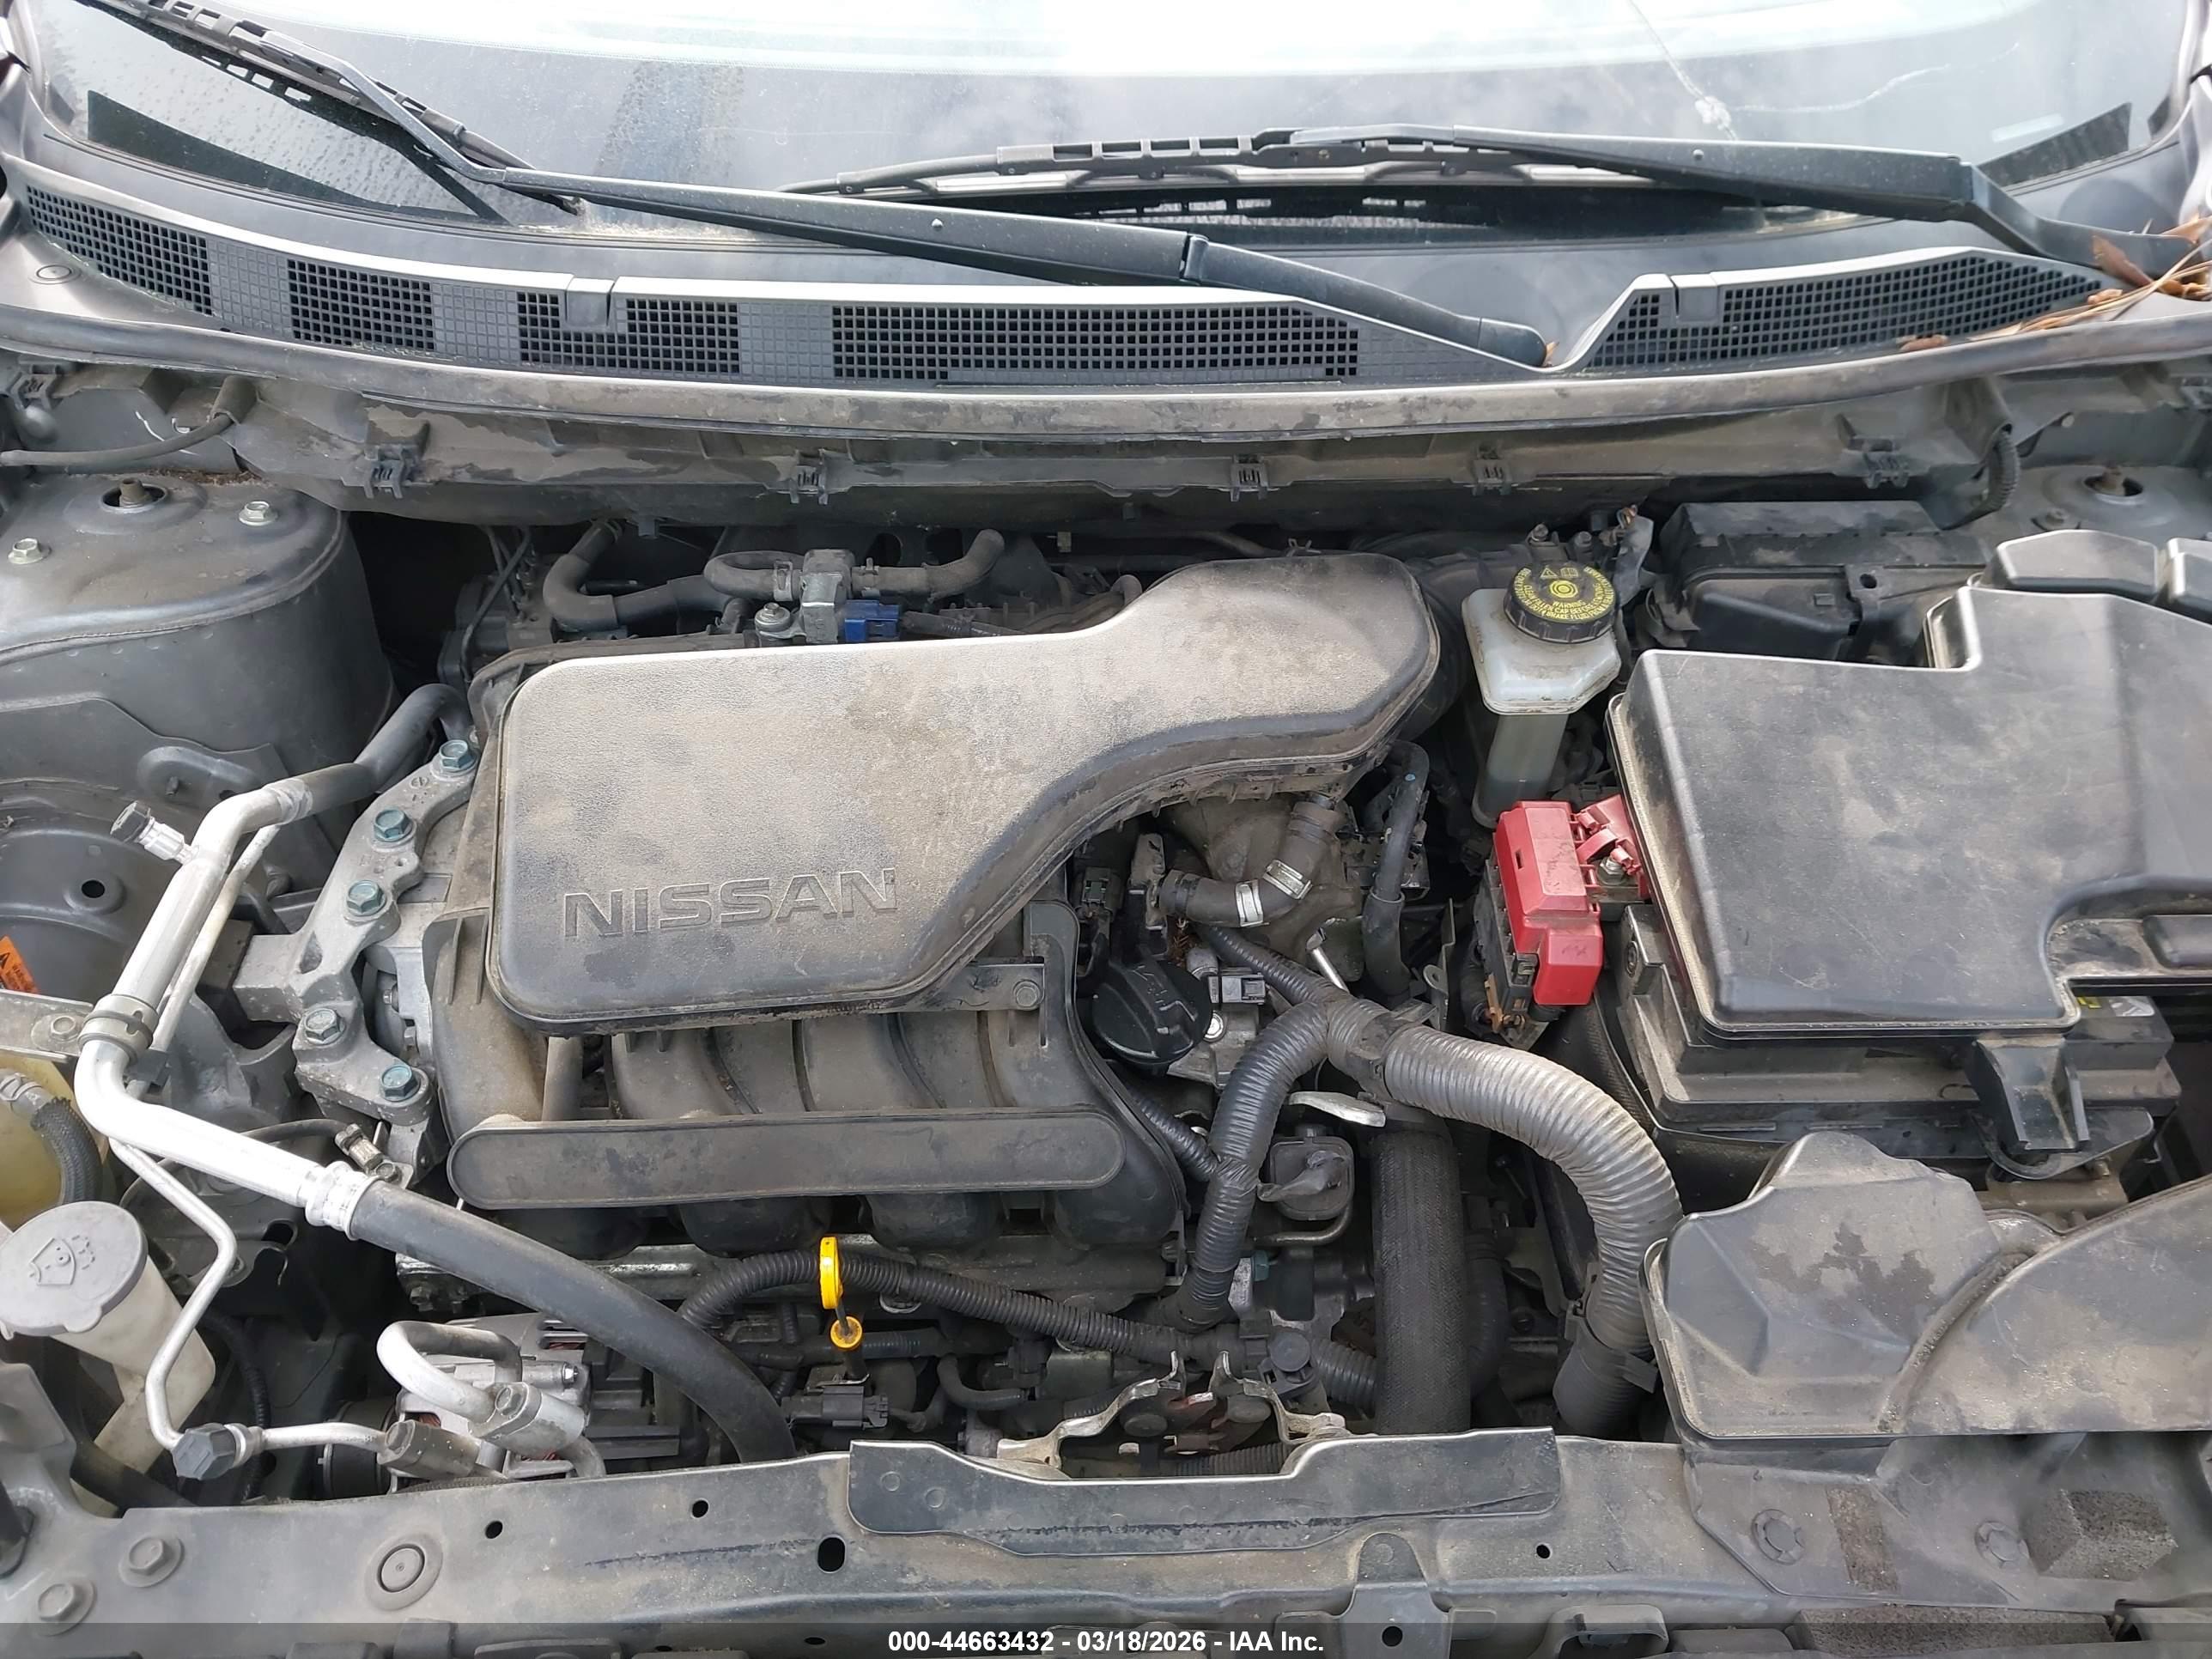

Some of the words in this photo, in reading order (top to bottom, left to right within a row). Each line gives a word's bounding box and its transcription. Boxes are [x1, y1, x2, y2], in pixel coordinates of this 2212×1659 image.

[1552, 599, 1587, 609] WARNING
[1554, 605, 1570, 614] CAP
[1546, 611, 1570, 619] BRAKE
[563, 867, 898, 938] NISSAN
